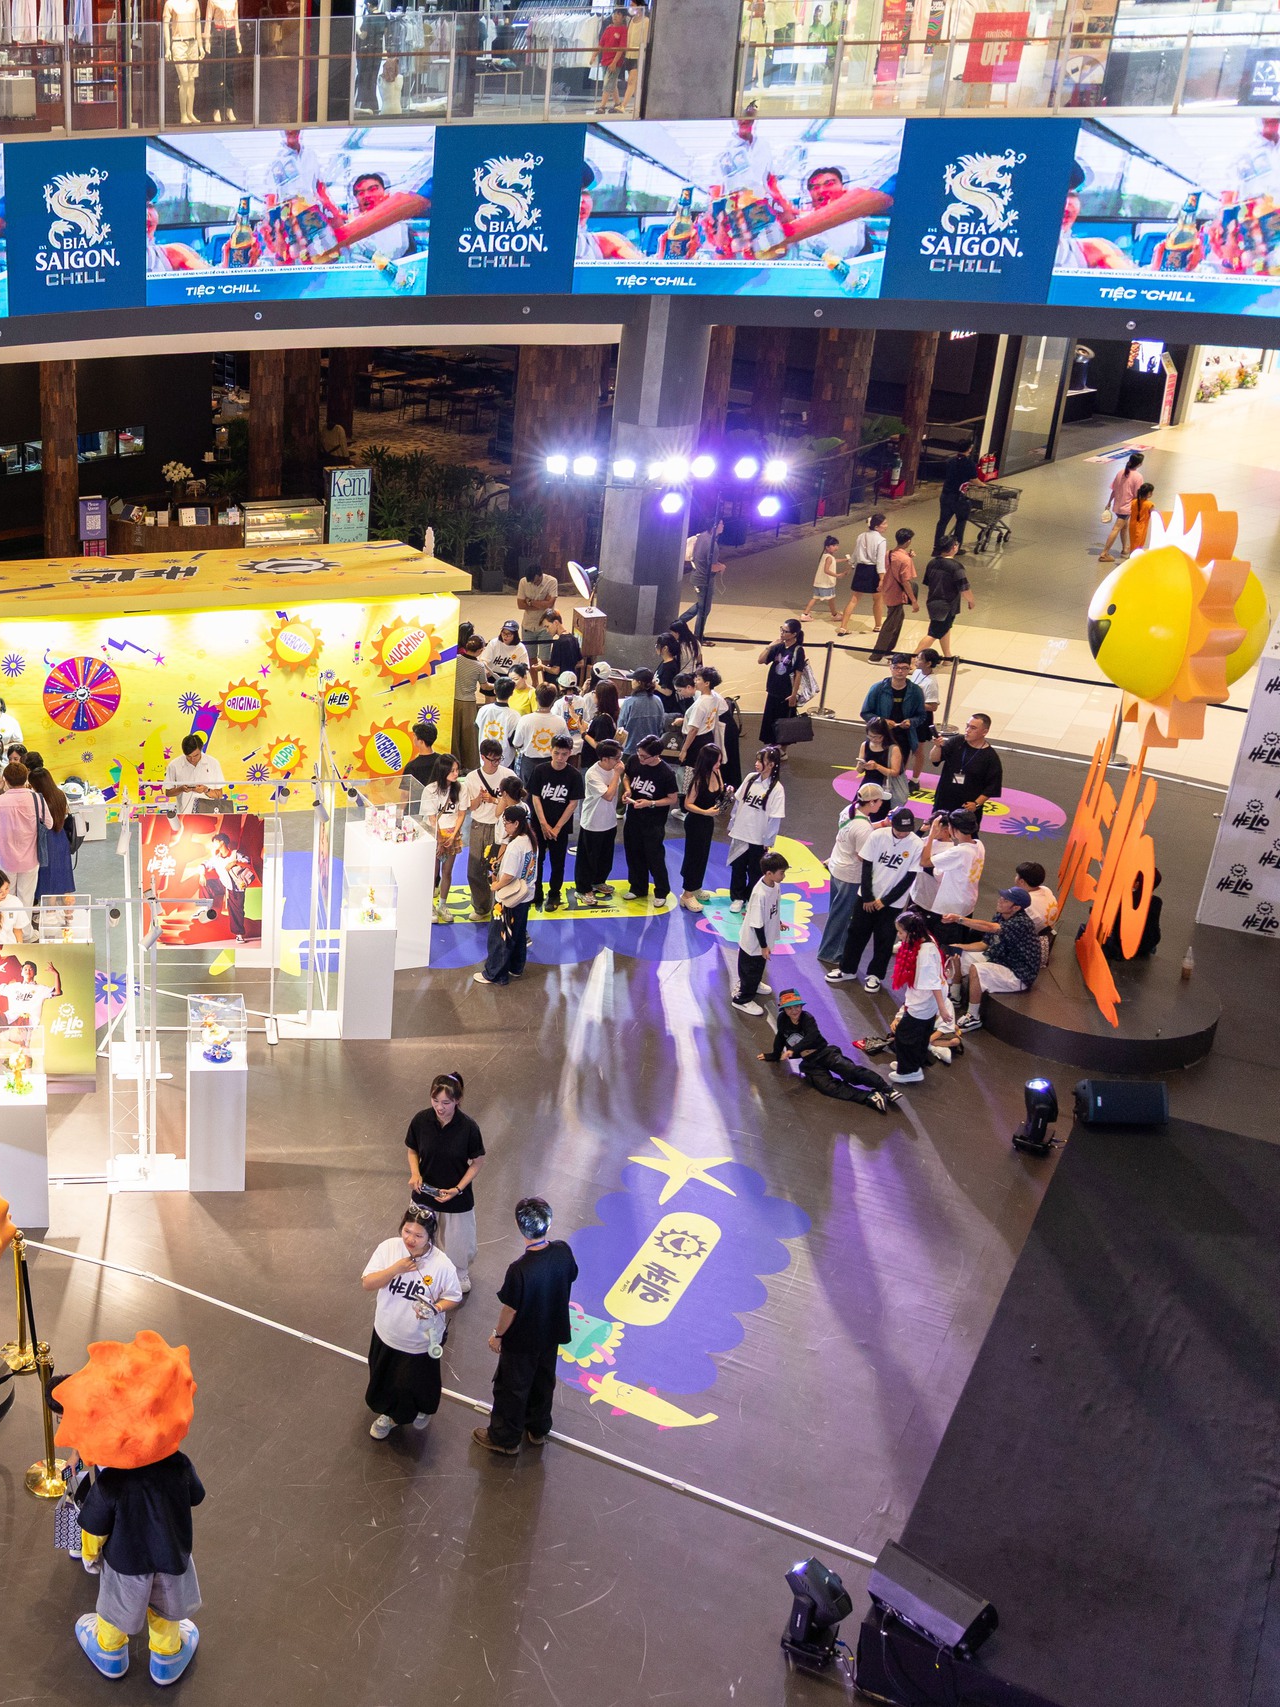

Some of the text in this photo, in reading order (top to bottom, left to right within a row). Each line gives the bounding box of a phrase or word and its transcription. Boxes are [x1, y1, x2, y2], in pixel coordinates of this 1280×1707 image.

[980, 42, 1010, 66] OFF
[489, 222, 515, 233] BIA
[957, 222, 987, 235] BIA
[64, 237, 88, 250] BIA
[468, 256, 531, 268] CHILL
[929, 258, 1002, 274] CHILL
[46, 270, 106, 287] CHILL
[615, 274, 647, 288] TIỆC
[186, 284, 215, 298] TIỆC
[1099, 286, 1137, 302] TIỆC
[386, 630, 425, 666] LAUGHING
[226, 696, 260, 710] ORIGINAL
[273, 744, 296, 768] HAPPY
[374, 732, 402, 770] INTERESTING
